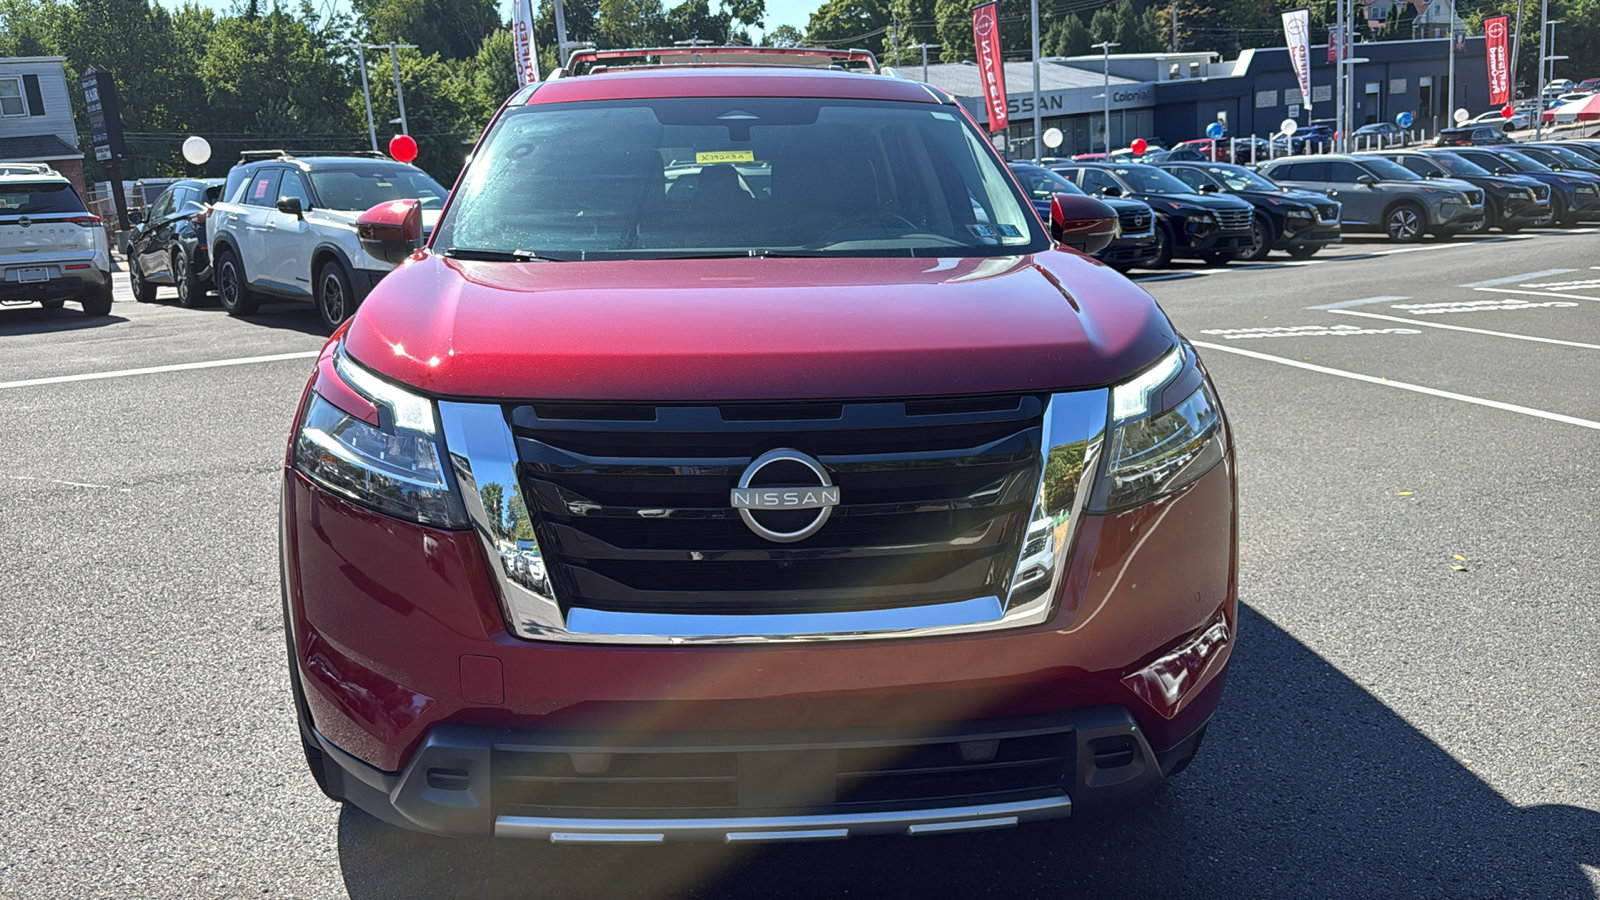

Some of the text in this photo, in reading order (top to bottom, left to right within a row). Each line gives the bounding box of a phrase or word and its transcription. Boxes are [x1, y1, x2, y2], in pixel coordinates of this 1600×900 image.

[1113, 88, 1149, 103] Colonial
[985, 95, 1063, 116] SSAN
[734, 490, 837, 506] NISSAN
